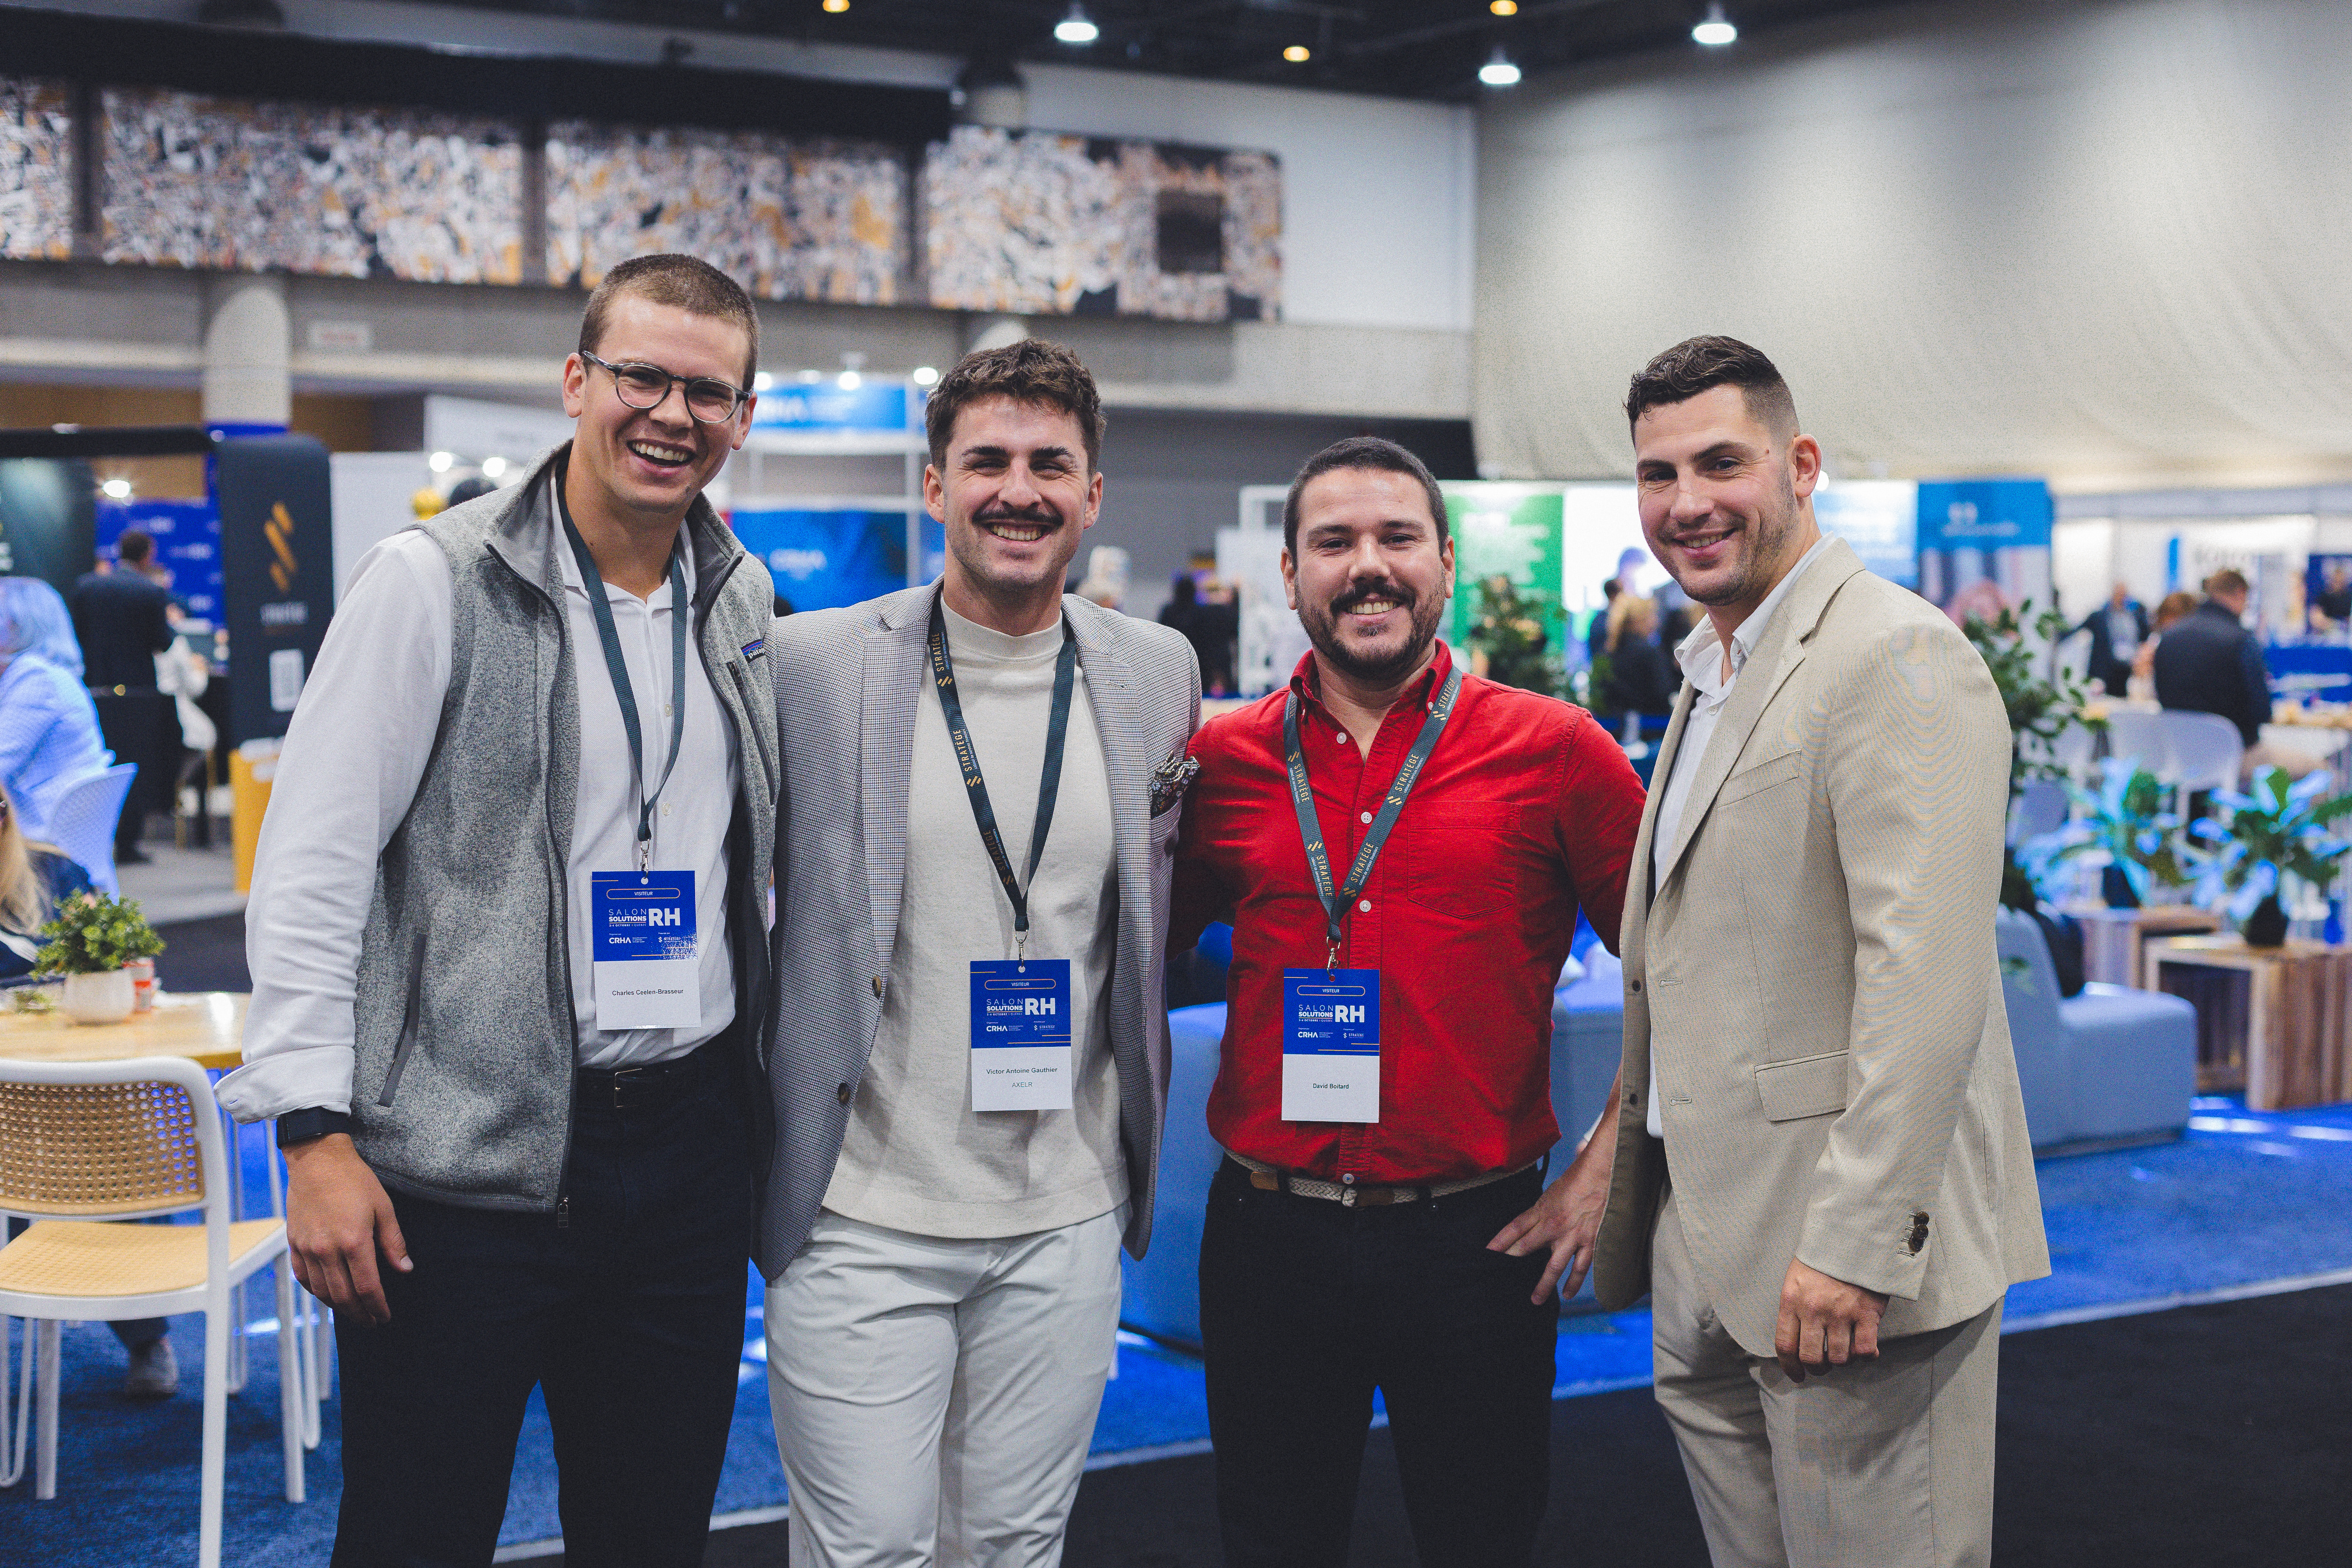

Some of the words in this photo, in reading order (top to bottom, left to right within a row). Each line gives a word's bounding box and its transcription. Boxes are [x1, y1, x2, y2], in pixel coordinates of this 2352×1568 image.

[931, 633, 944, 672] STRATÈGE
[1438, 678, 1456, 708] STRATÈGE
[953, 729, 972, 772] STRATÈGE
[1294, 763, 1309, 802] STRATÈGE
[1395, 754, 1419, 792] STRATÈGE
[983, 830, 1005, 871] STRATÈGE
[1351, 842, 1374, 883] STRATÈGE
[1316, 855, 1333, 896] STRATÈGE
[649, 908, 680, 926] RH
[1025, 998, 1055, 1015] RH
[1335, 1005, 1365, 1023] RH
